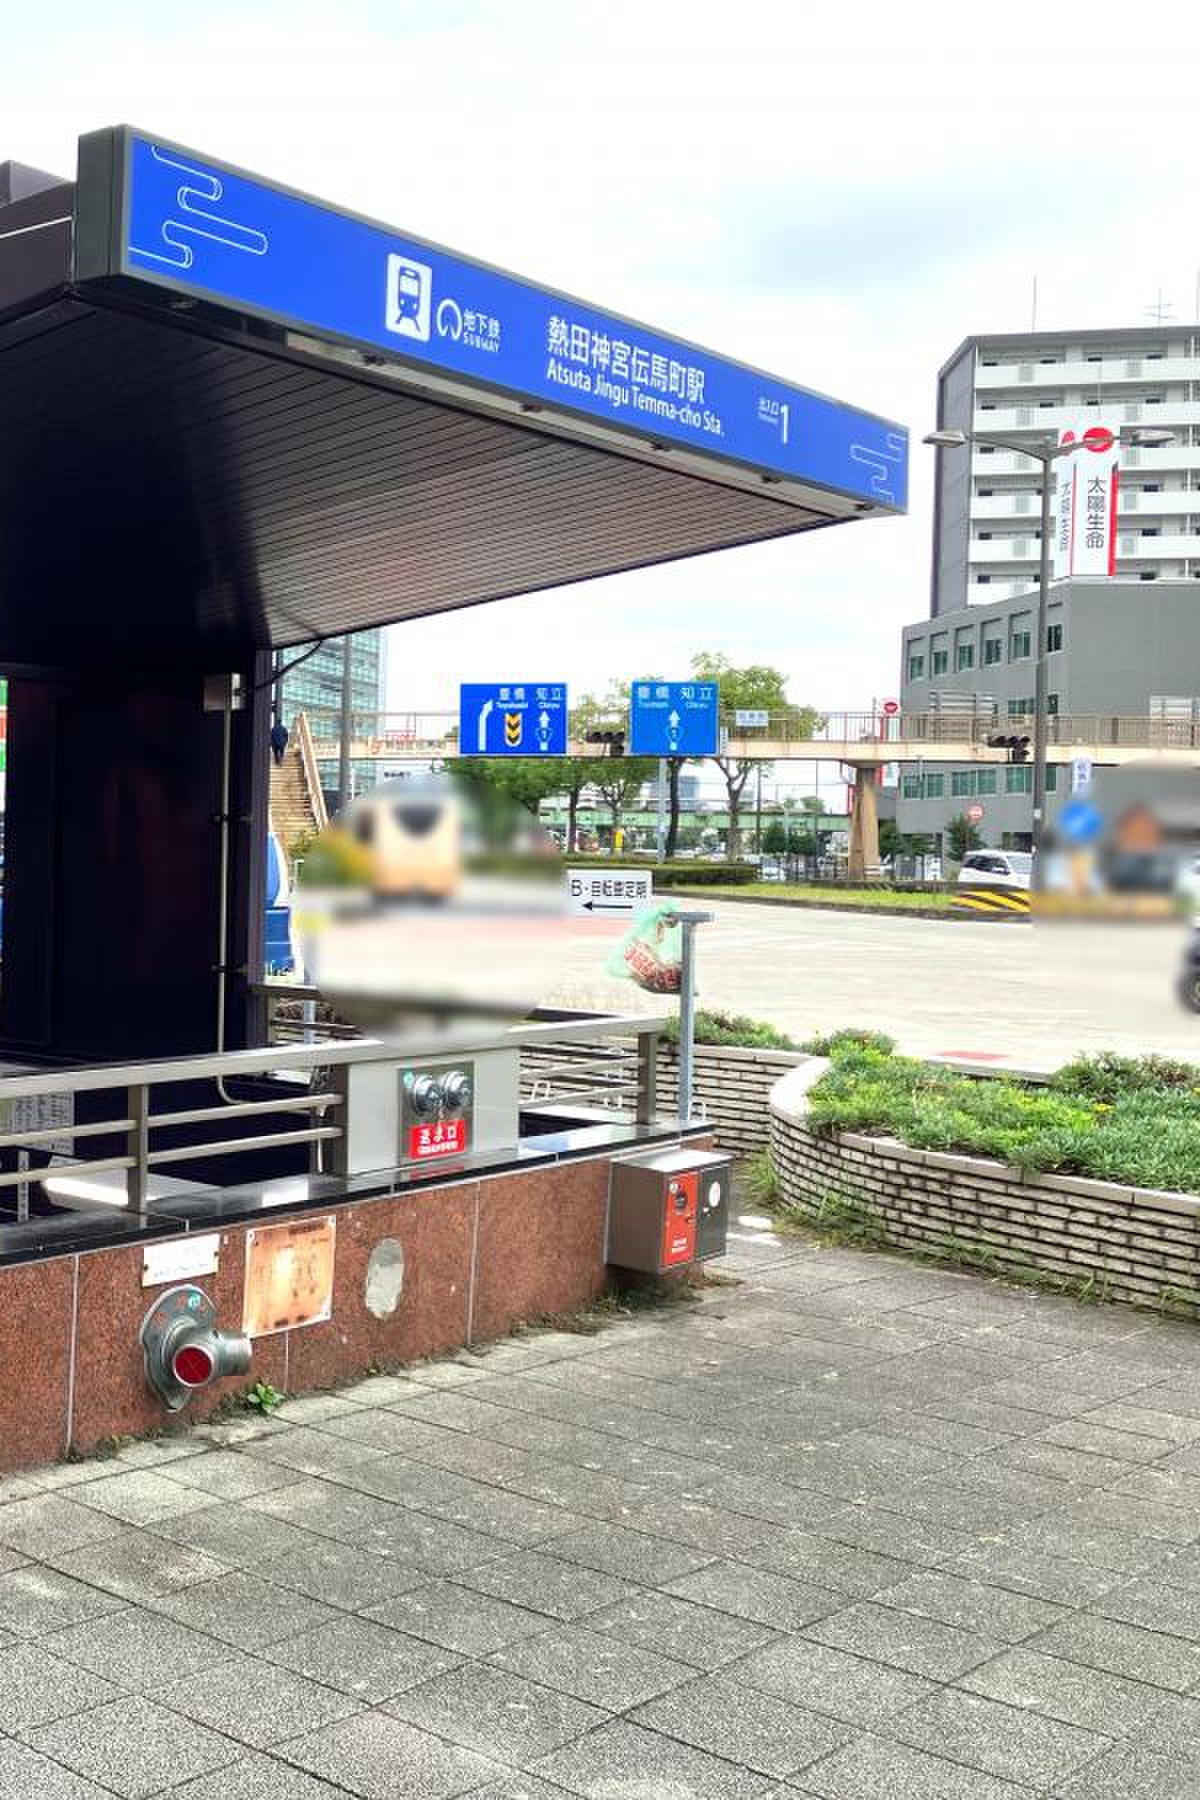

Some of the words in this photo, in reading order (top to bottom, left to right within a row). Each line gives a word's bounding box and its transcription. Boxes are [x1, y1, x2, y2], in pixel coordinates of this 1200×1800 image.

[463, 308, 500, 337] 地下鉄
[548, 315, 705, 404] 熱田神宮伝馬町駅
[546, 357, 592, 392] Atsuta
[593, 374, 629, 407] Jingu
[631, 386, 701, 429] Temma-cho
[703, 410, 725, 438] Sta.
[780, 403, 789, 445] 1
[1085, 476, 1107, 550] 太陽生命
[681, 687, 713, 700] 知立
